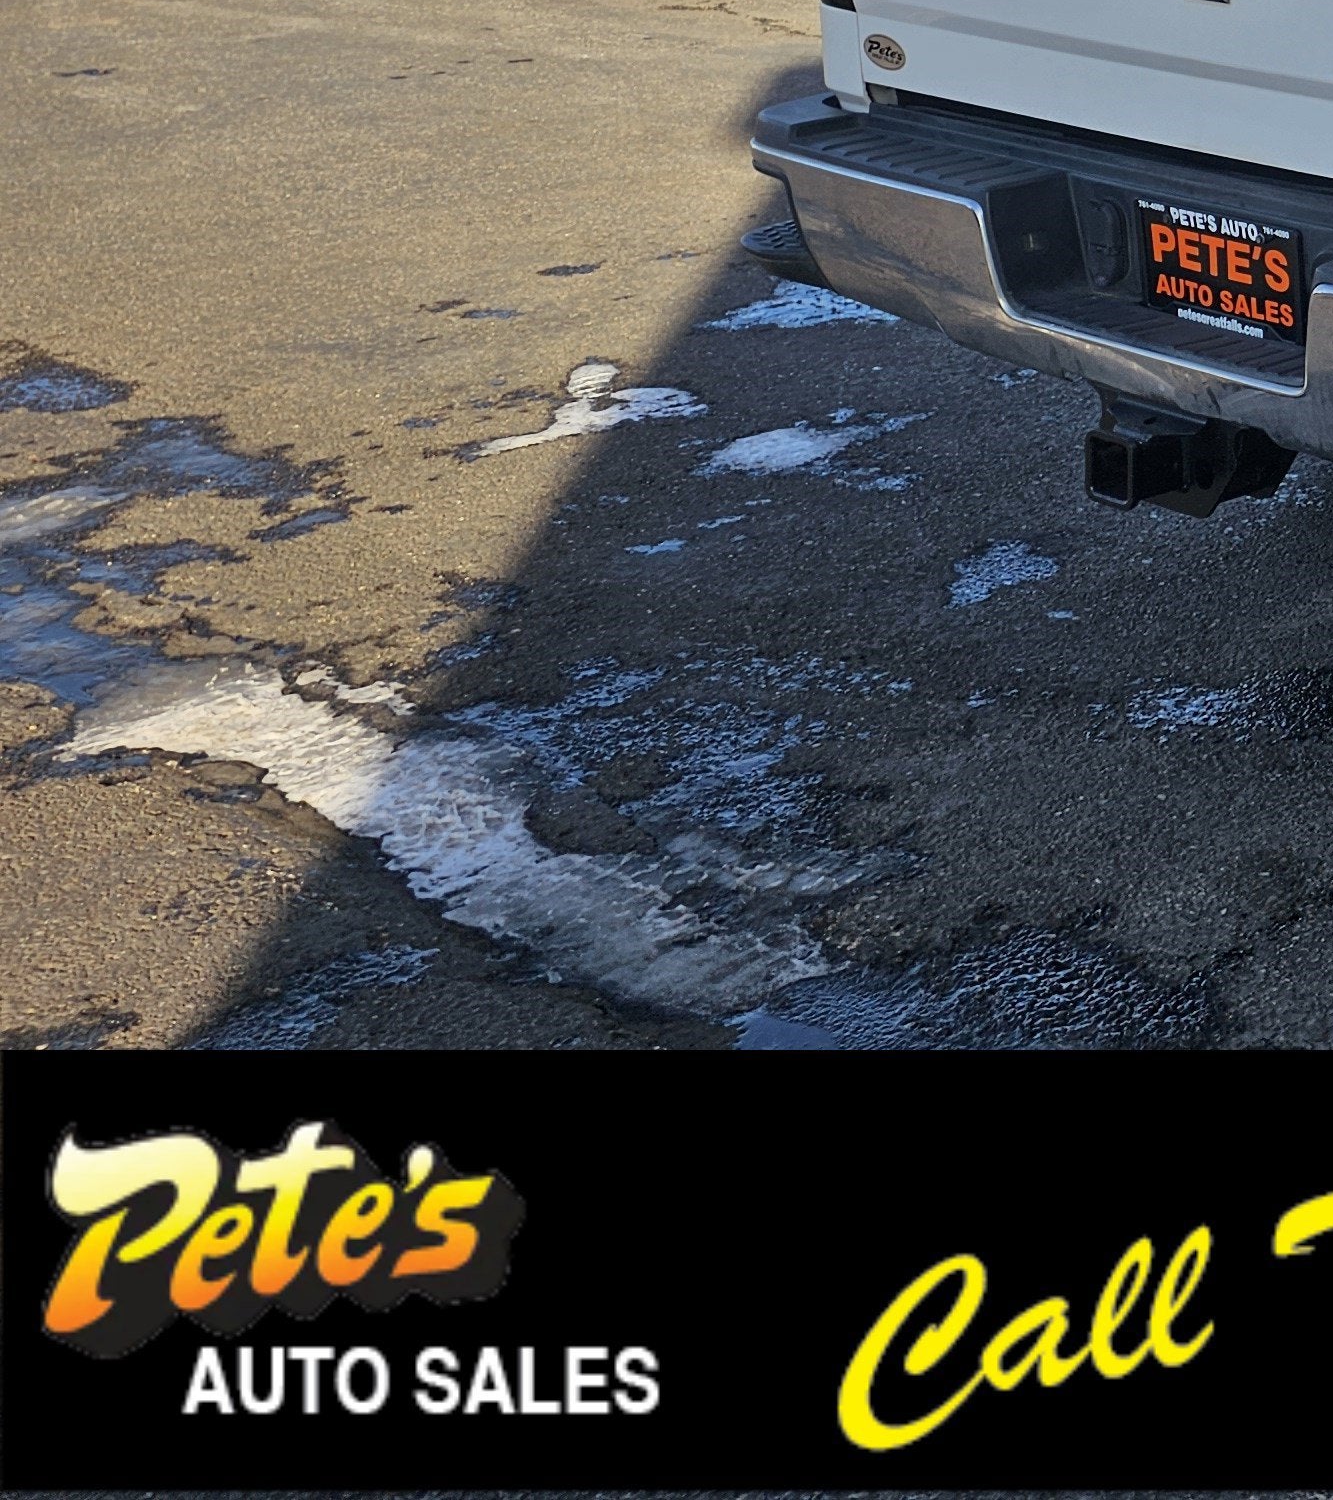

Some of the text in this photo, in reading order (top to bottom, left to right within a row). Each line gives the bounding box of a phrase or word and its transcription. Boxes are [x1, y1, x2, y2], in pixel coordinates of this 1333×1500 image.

[1169, 206, 1258, 242] PETE'S AUTO
[1150, 223, 1291, 293] PETE'S
[1156, 273, 1294, 328] AUTO SALES
